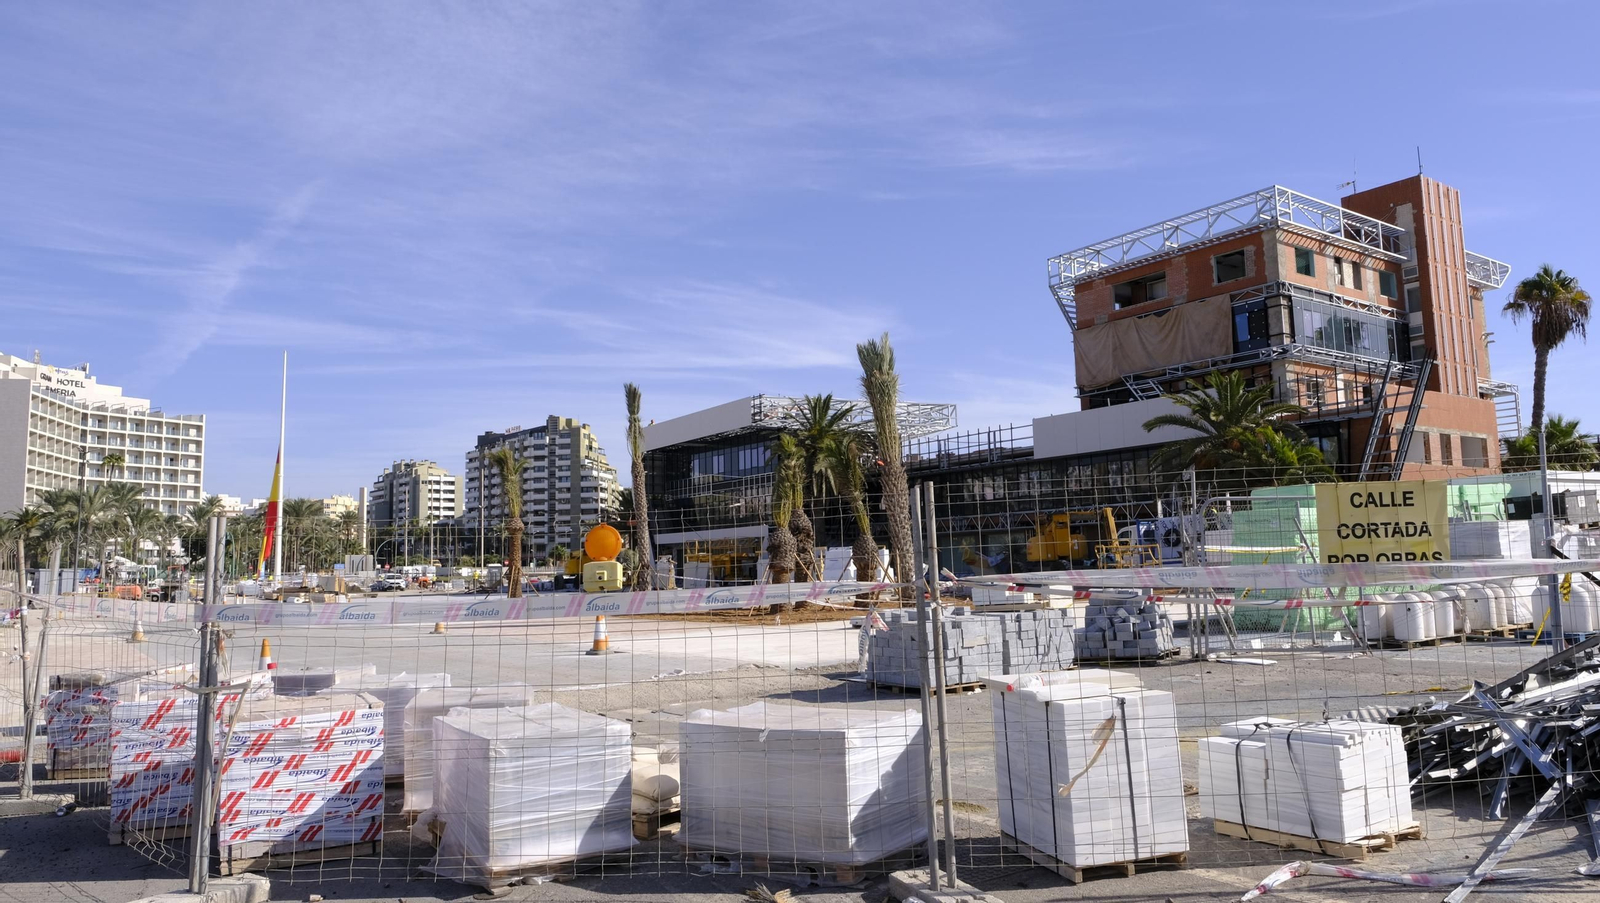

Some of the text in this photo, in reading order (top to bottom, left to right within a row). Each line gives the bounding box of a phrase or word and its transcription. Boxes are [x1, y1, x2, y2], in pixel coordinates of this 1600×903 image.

[40, 372, 86, 388] GRAN HOTEL
[1350, 491, 1414, 508] CALLE
[1336, 521, 1432, 540] CORTADA
[216, 613, 250, 622] albaida
[338, 611, 376, 620] albaida
[464, 608, 500, 617] albaida
[585, 603, 620, 612] albaida
[705, 596, 740, 605] albaida
[340, 726, 377, 735] albaida
[344, 738, 384, 746] albaida
[243, 756, 284, 764] albaida
[288, 768, 330, 777] albaida
